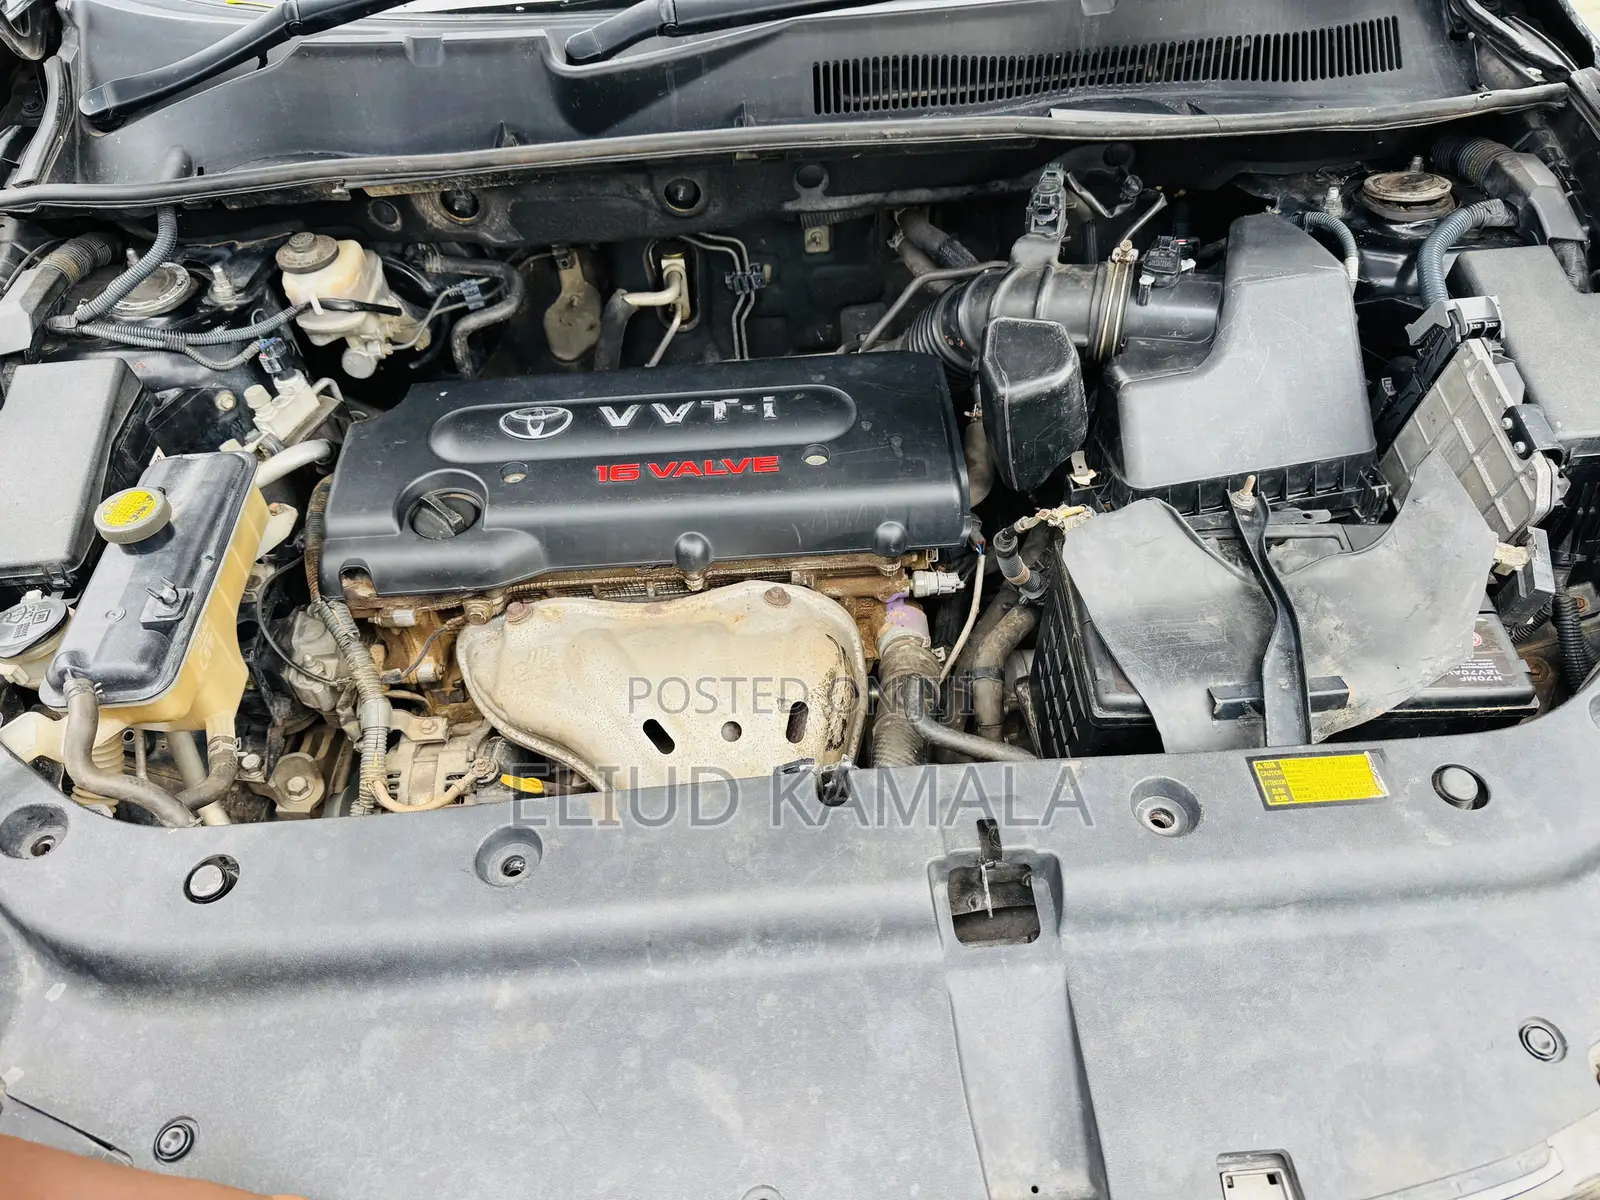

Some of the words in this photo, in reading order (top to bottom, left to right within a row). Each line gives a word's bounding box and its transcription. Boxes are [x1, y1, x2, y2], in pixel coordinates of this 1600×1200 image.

[598, 396, 778, 429] VVT-i
[596, 463, 641, 483] 16
[647, 455, 781, 480] VALVE
[1260, 769, 1283, 777] CAUTION
